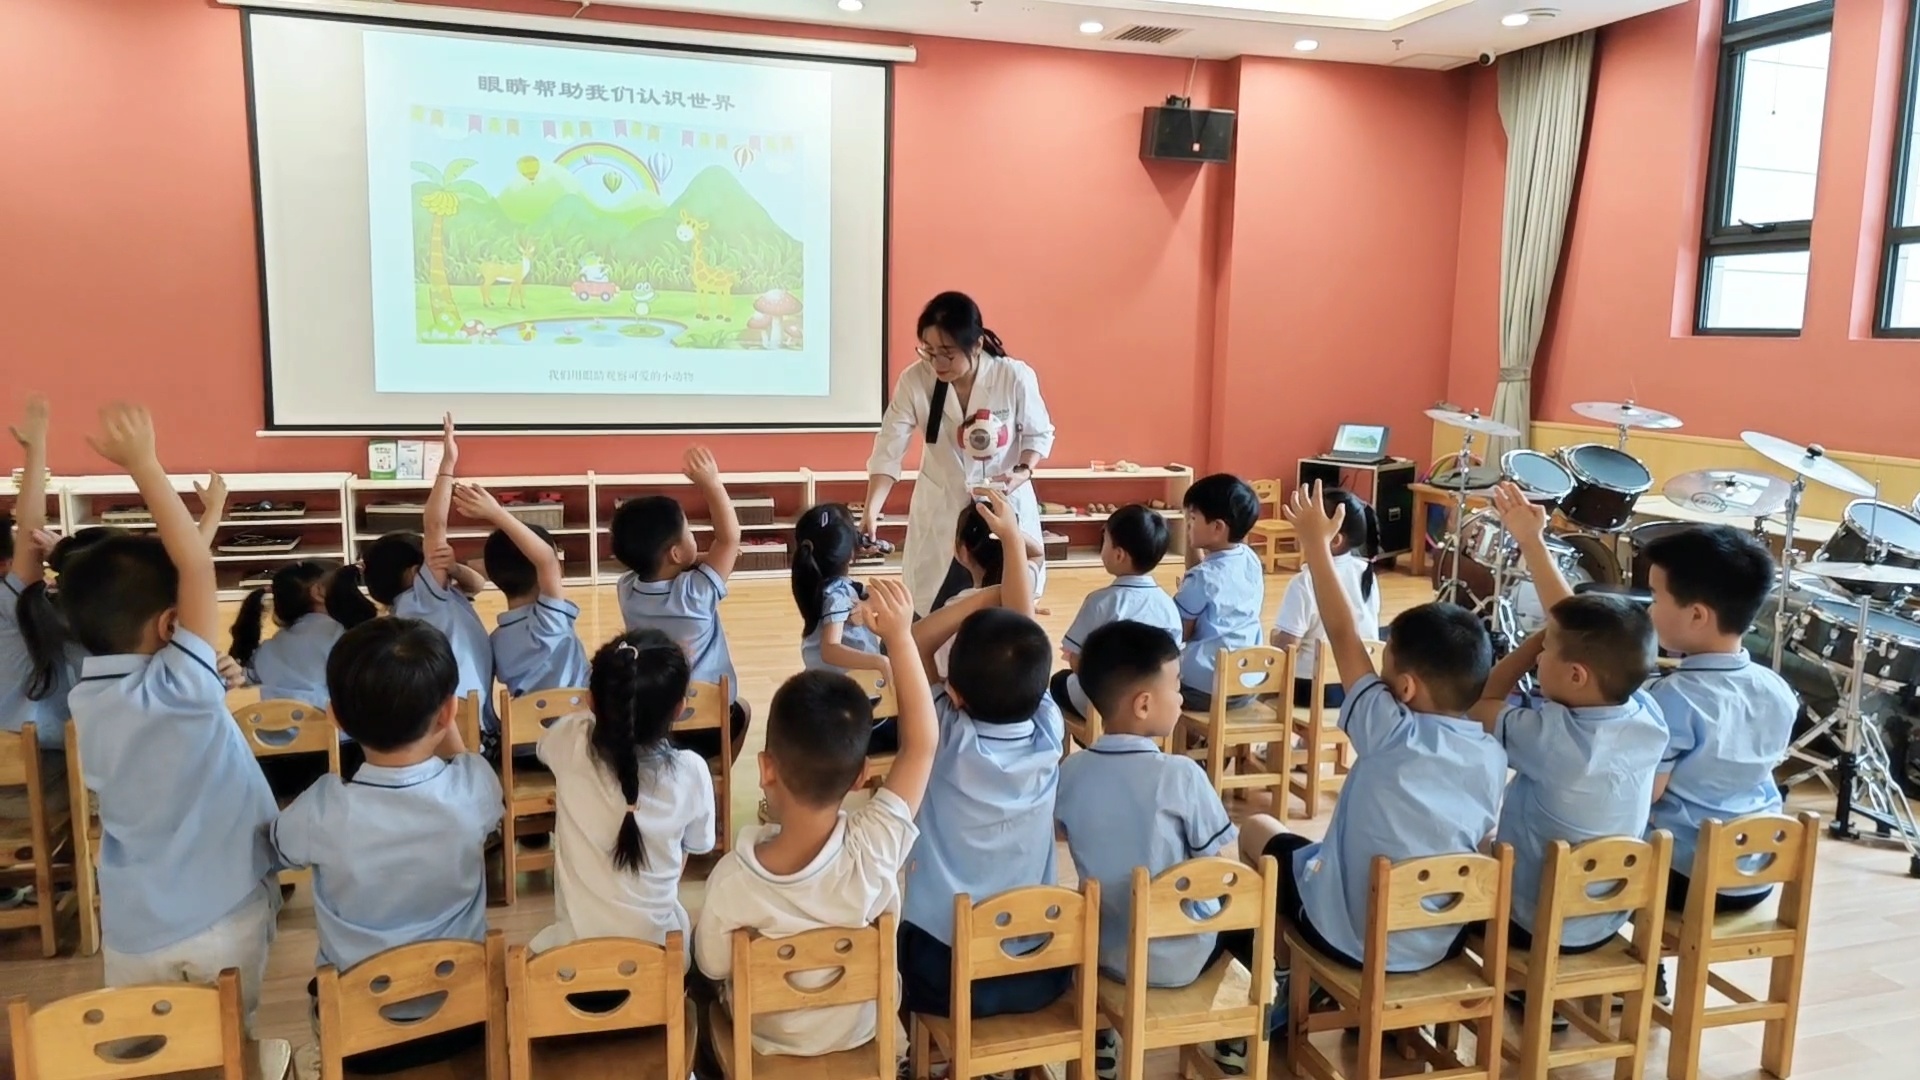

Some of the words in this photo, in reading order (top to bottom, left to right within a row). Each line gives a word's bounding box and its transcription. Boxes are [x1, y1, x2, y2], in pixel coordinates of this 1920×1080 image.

[478, 75, 736, 112] 眼睛帮助我们认识世界
